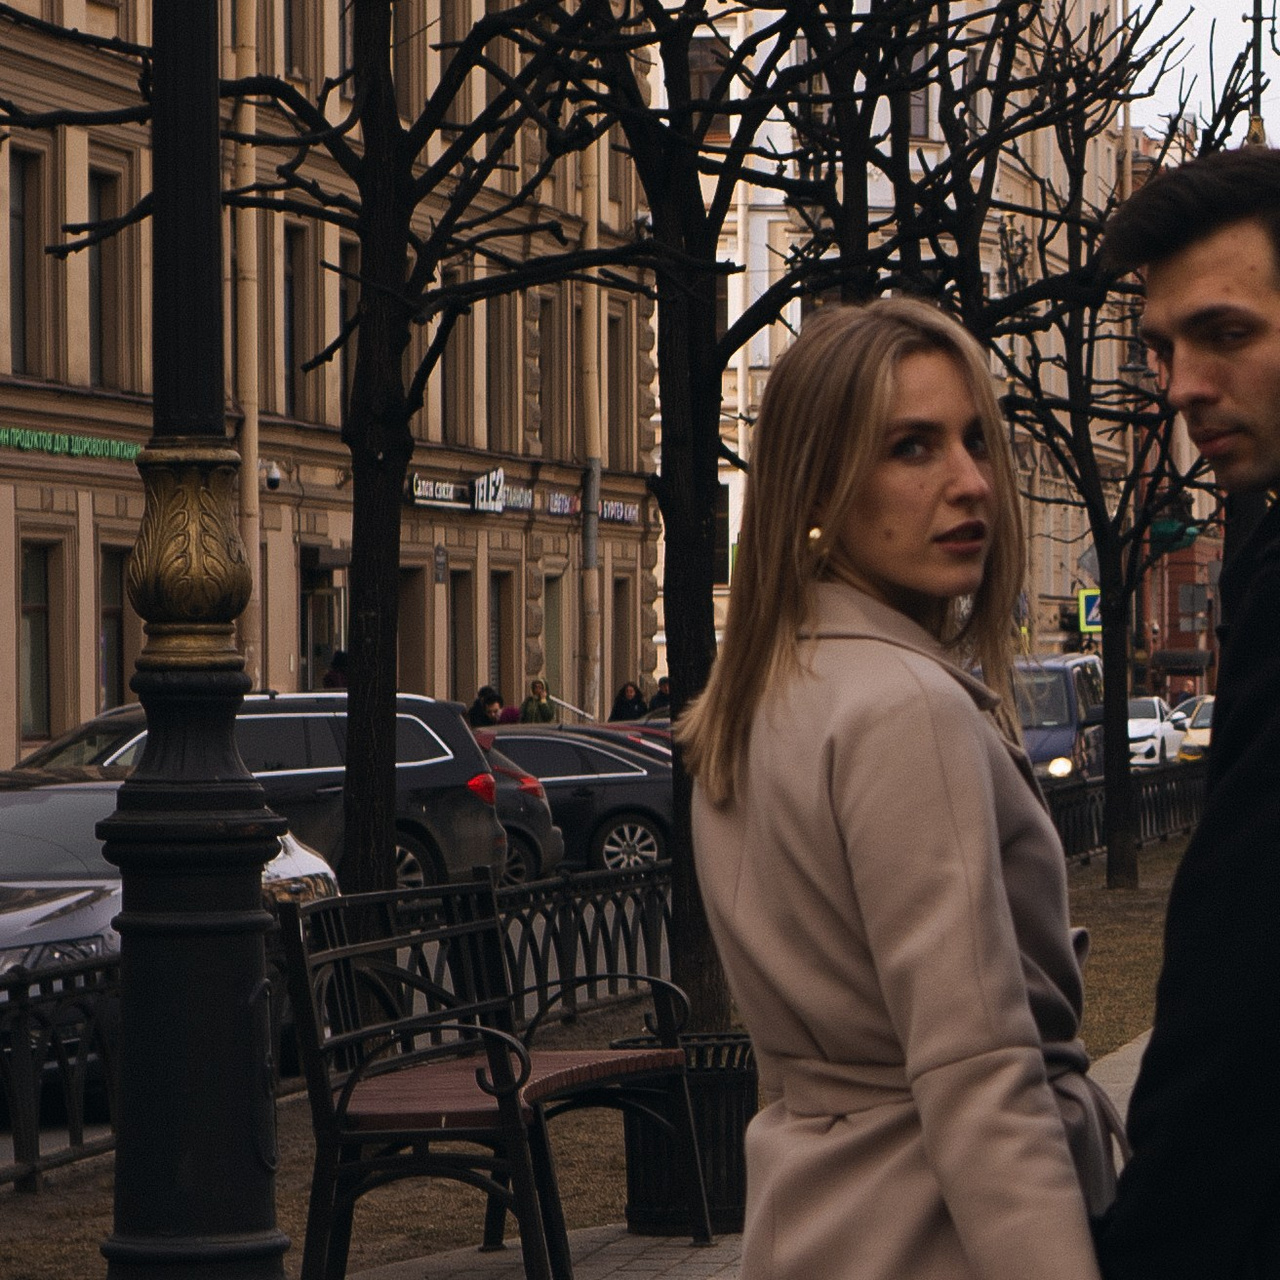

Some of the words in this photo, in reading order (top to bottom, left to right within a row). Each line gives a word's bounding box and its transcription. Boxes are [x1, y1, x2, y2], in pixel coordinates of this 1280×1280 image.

[10, 428, 52, 452] ПРОДУКТОВ
[71, 434, 109, 457] ЗДОРОВОГО
[475, 467, 504, 513] TELE2
